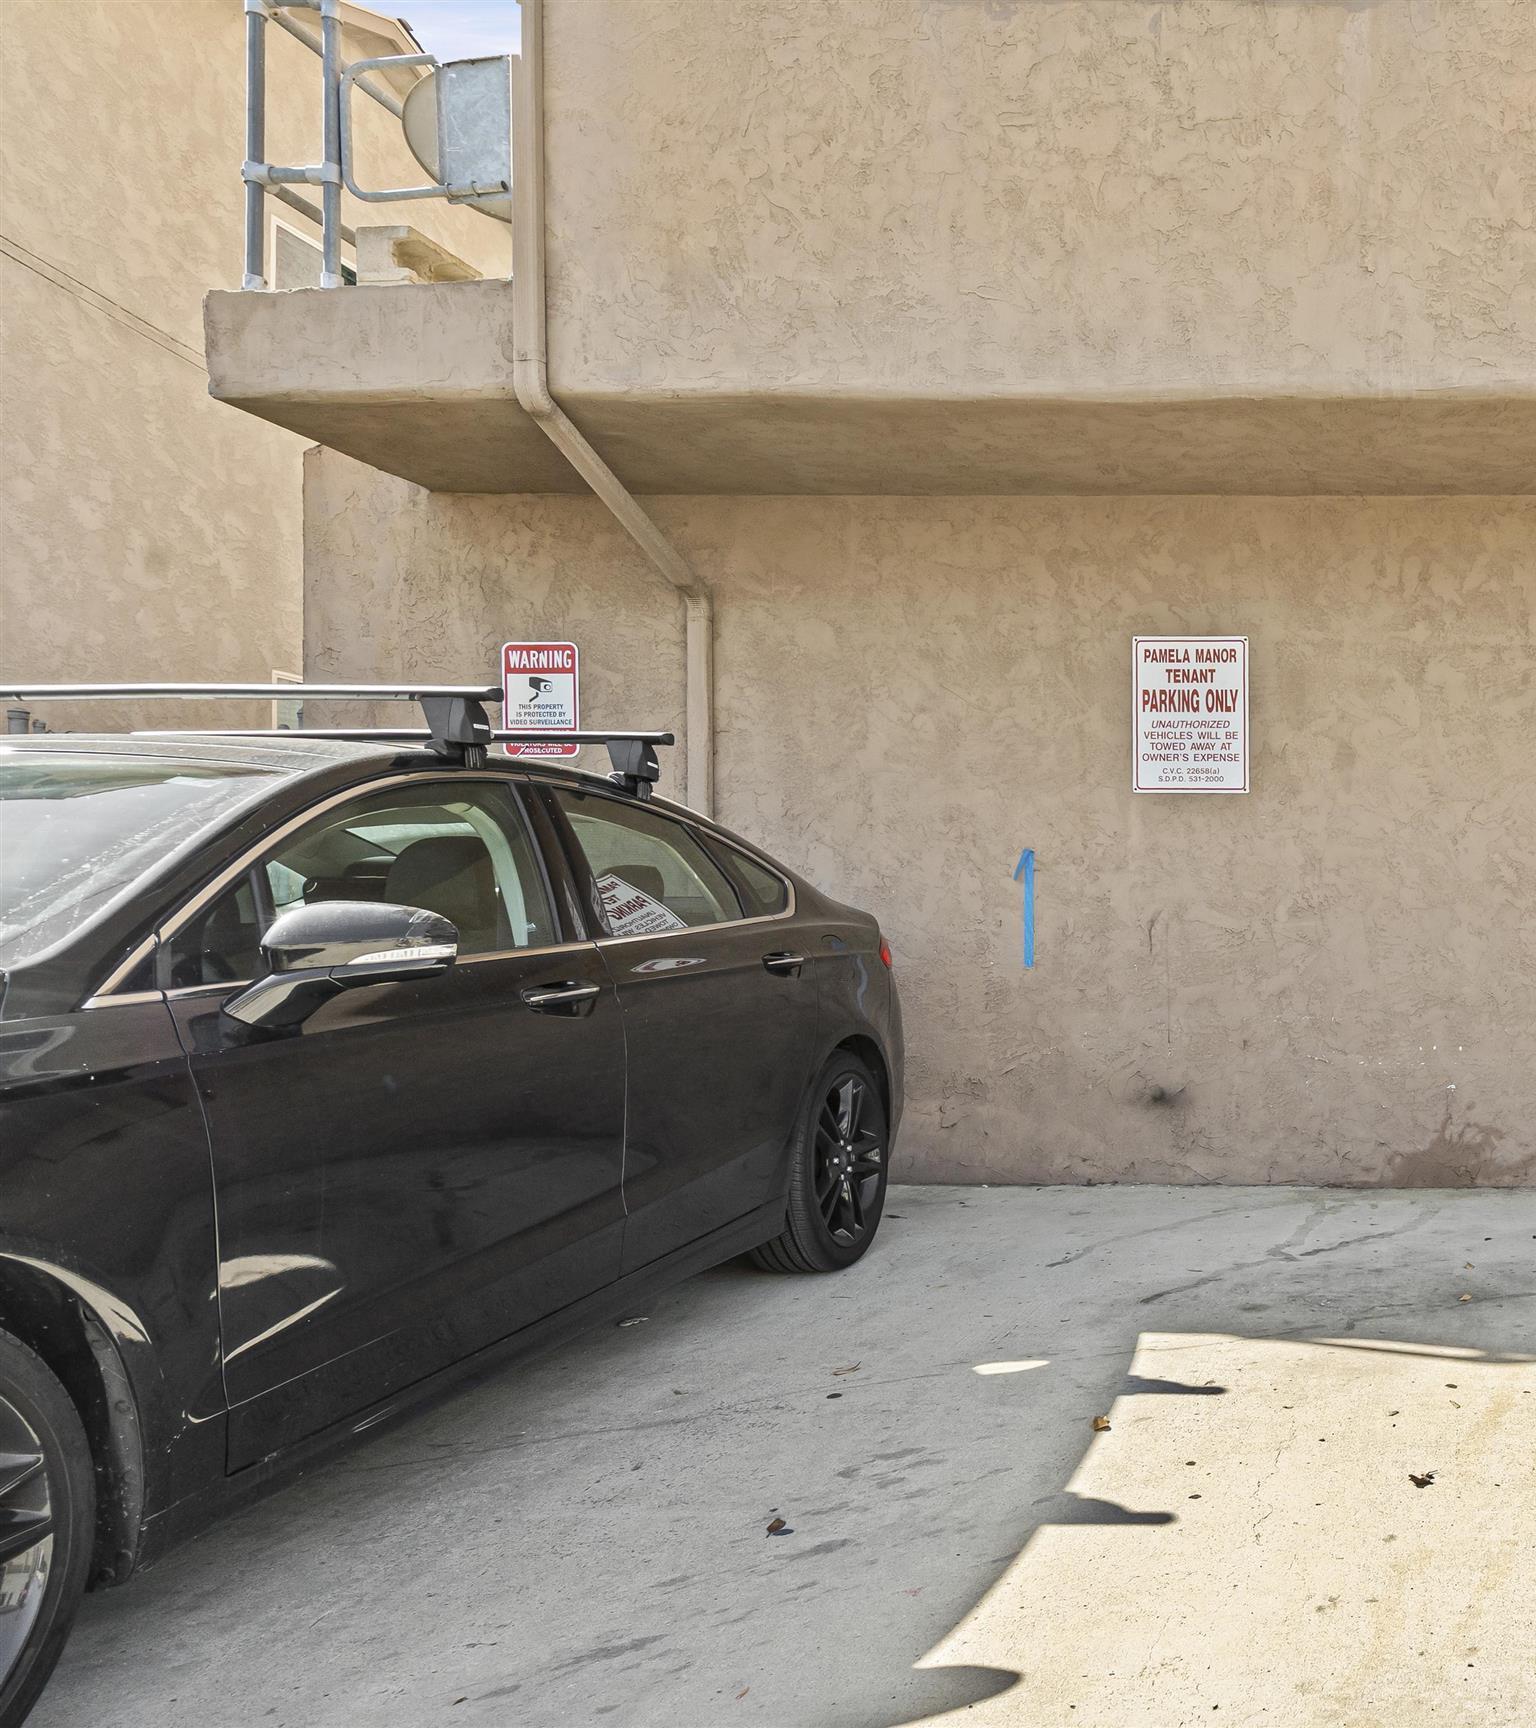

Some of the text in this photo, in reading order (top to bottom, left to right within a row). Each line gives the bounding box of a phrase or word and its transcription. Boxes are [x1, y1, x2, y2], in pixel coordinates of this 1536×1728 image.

[508, 650, 572, 669] WARNING
[1144, 648, 1237, 663] PAMELA MANOR
[1165, 668, 1216, 683] TENANT
[1142, 689, 1239, 713] PARKING ONLY
[1151, 720, 1231, 729] UNAUTHORIZED
[1143, 731, 1239, 740] VEHICLES WILL BE
[1150, 742, 1232, 751] TOWED AWAY AT
[1142, 753, 1240, 762] OWNER'S EXPENSE
[1162, 767, 1220, 775] C.V.C. 22658(a)
[1158, 775, 1225, 783] S.D.P.D. 531-2000
